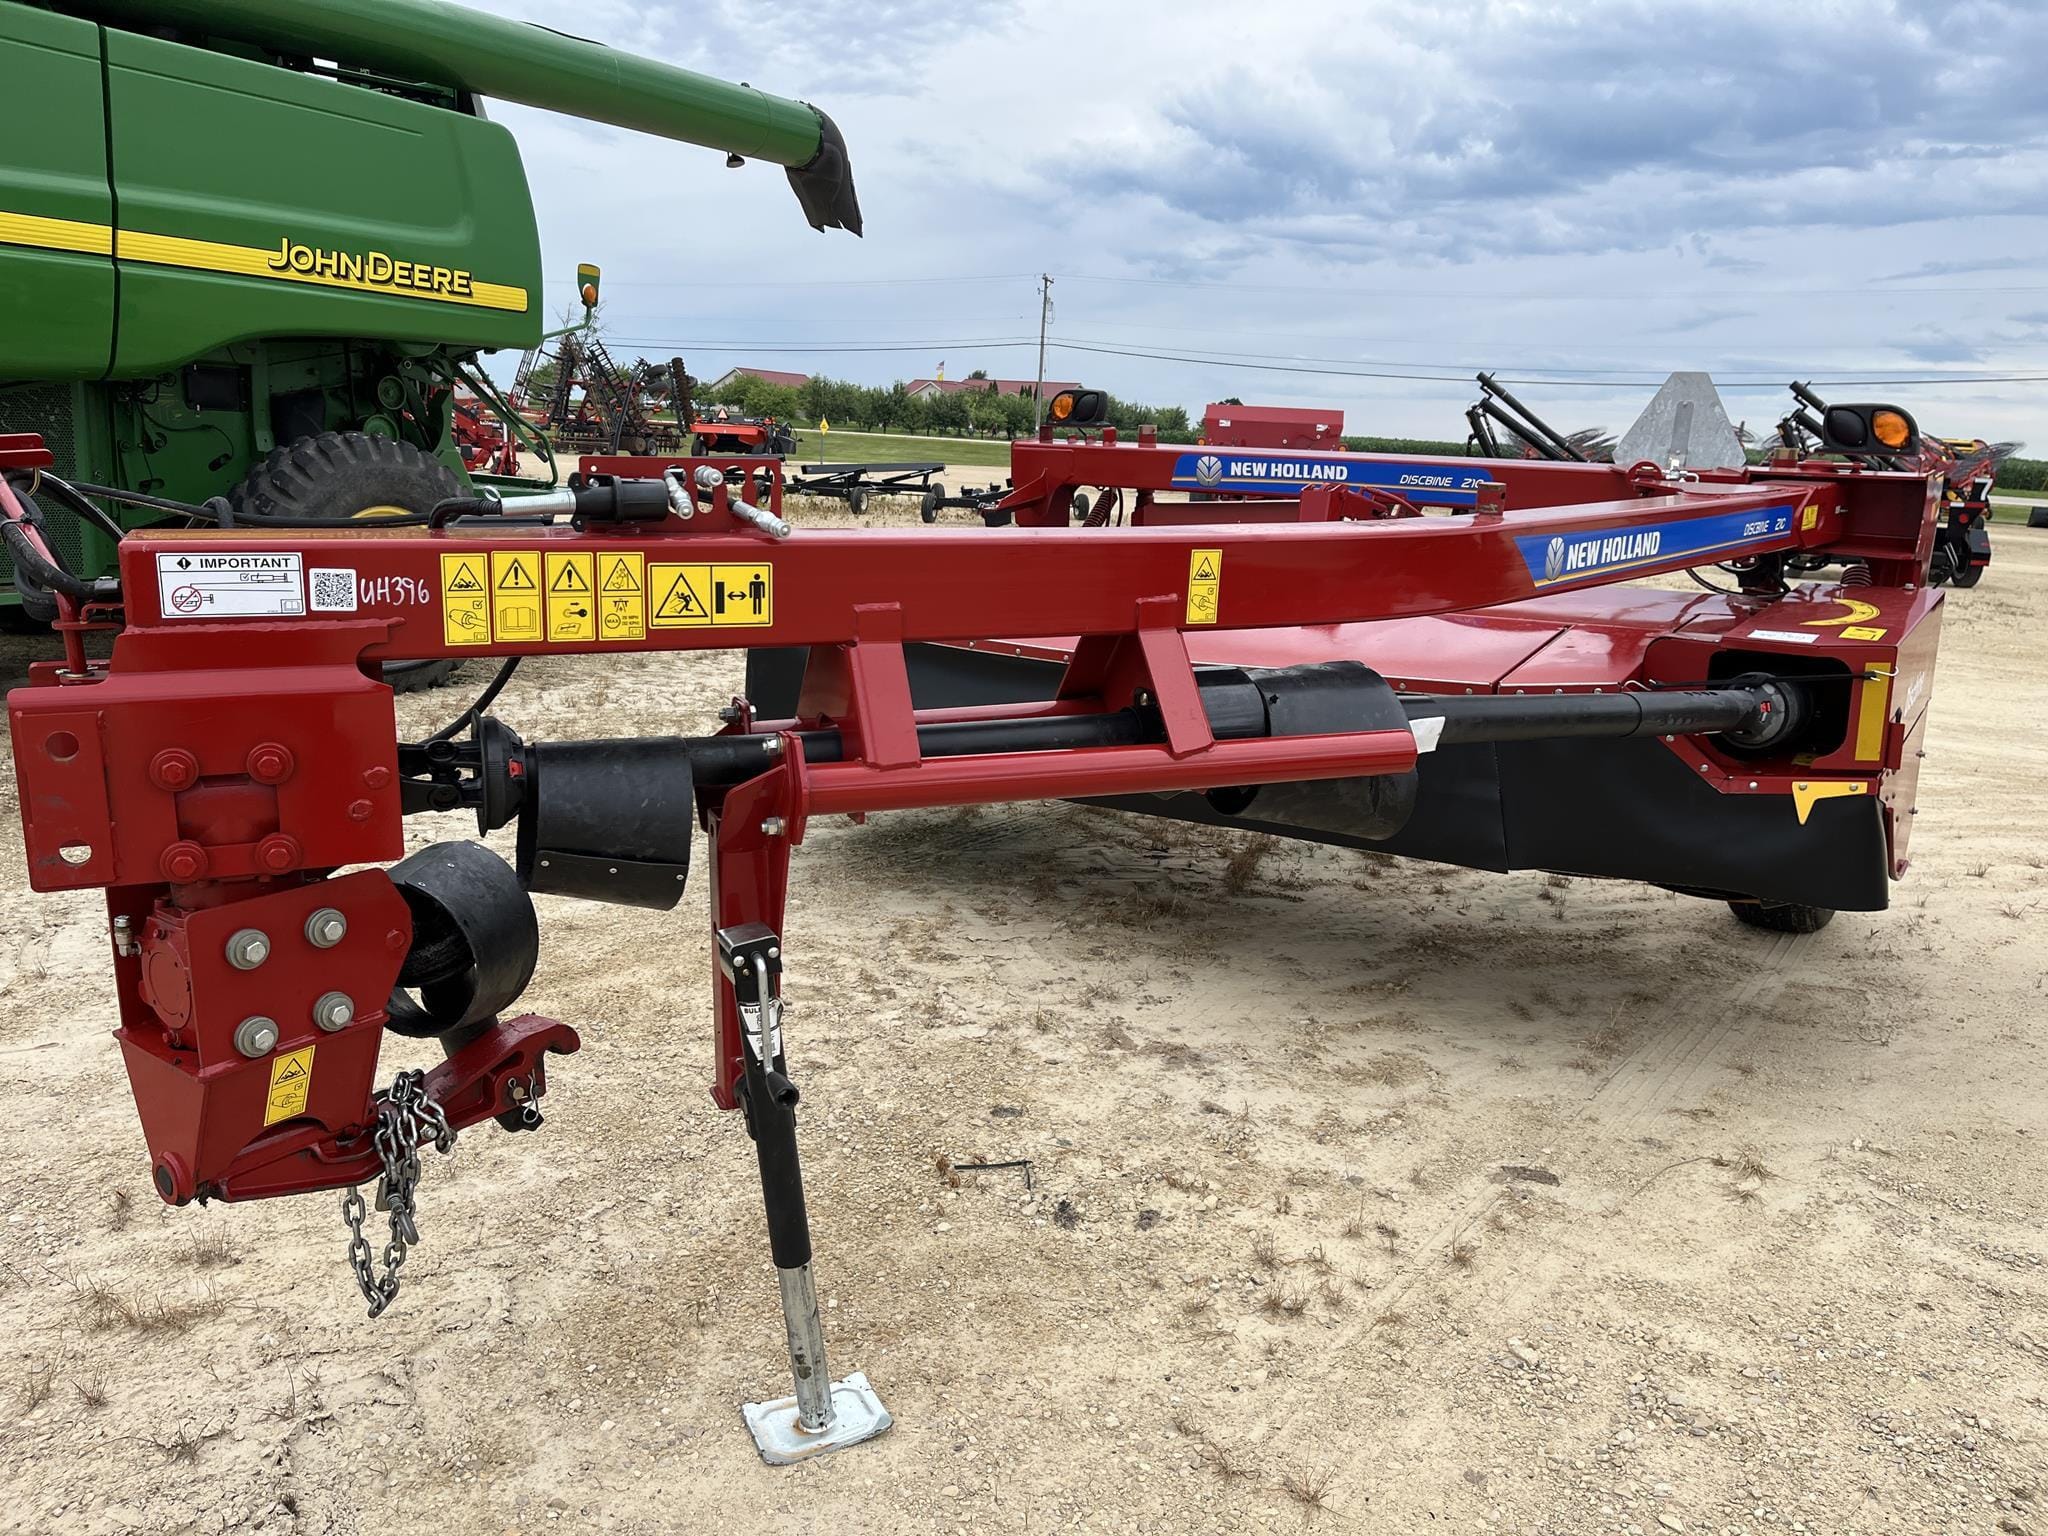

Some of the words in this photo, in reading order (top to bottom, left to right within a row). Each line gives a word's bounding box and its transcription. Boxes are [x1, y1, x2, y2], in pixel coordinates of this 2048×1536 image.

[267, 237, 363, 280] JOHN
[366, 251, 473, 296] DEERE
[1230, 462, 1267, 476] NEW
[1270, 463, 1348, 480] HOLLAND
[1400, 474, 1453, 487] DISCBINE
[1566, 540, 1601, 570] NEW
[1601, 531, 1660, 564] HOLLAND
[200, 557, 291, 569] IMPORTANT
[360, 576, 430, 606] UH396
